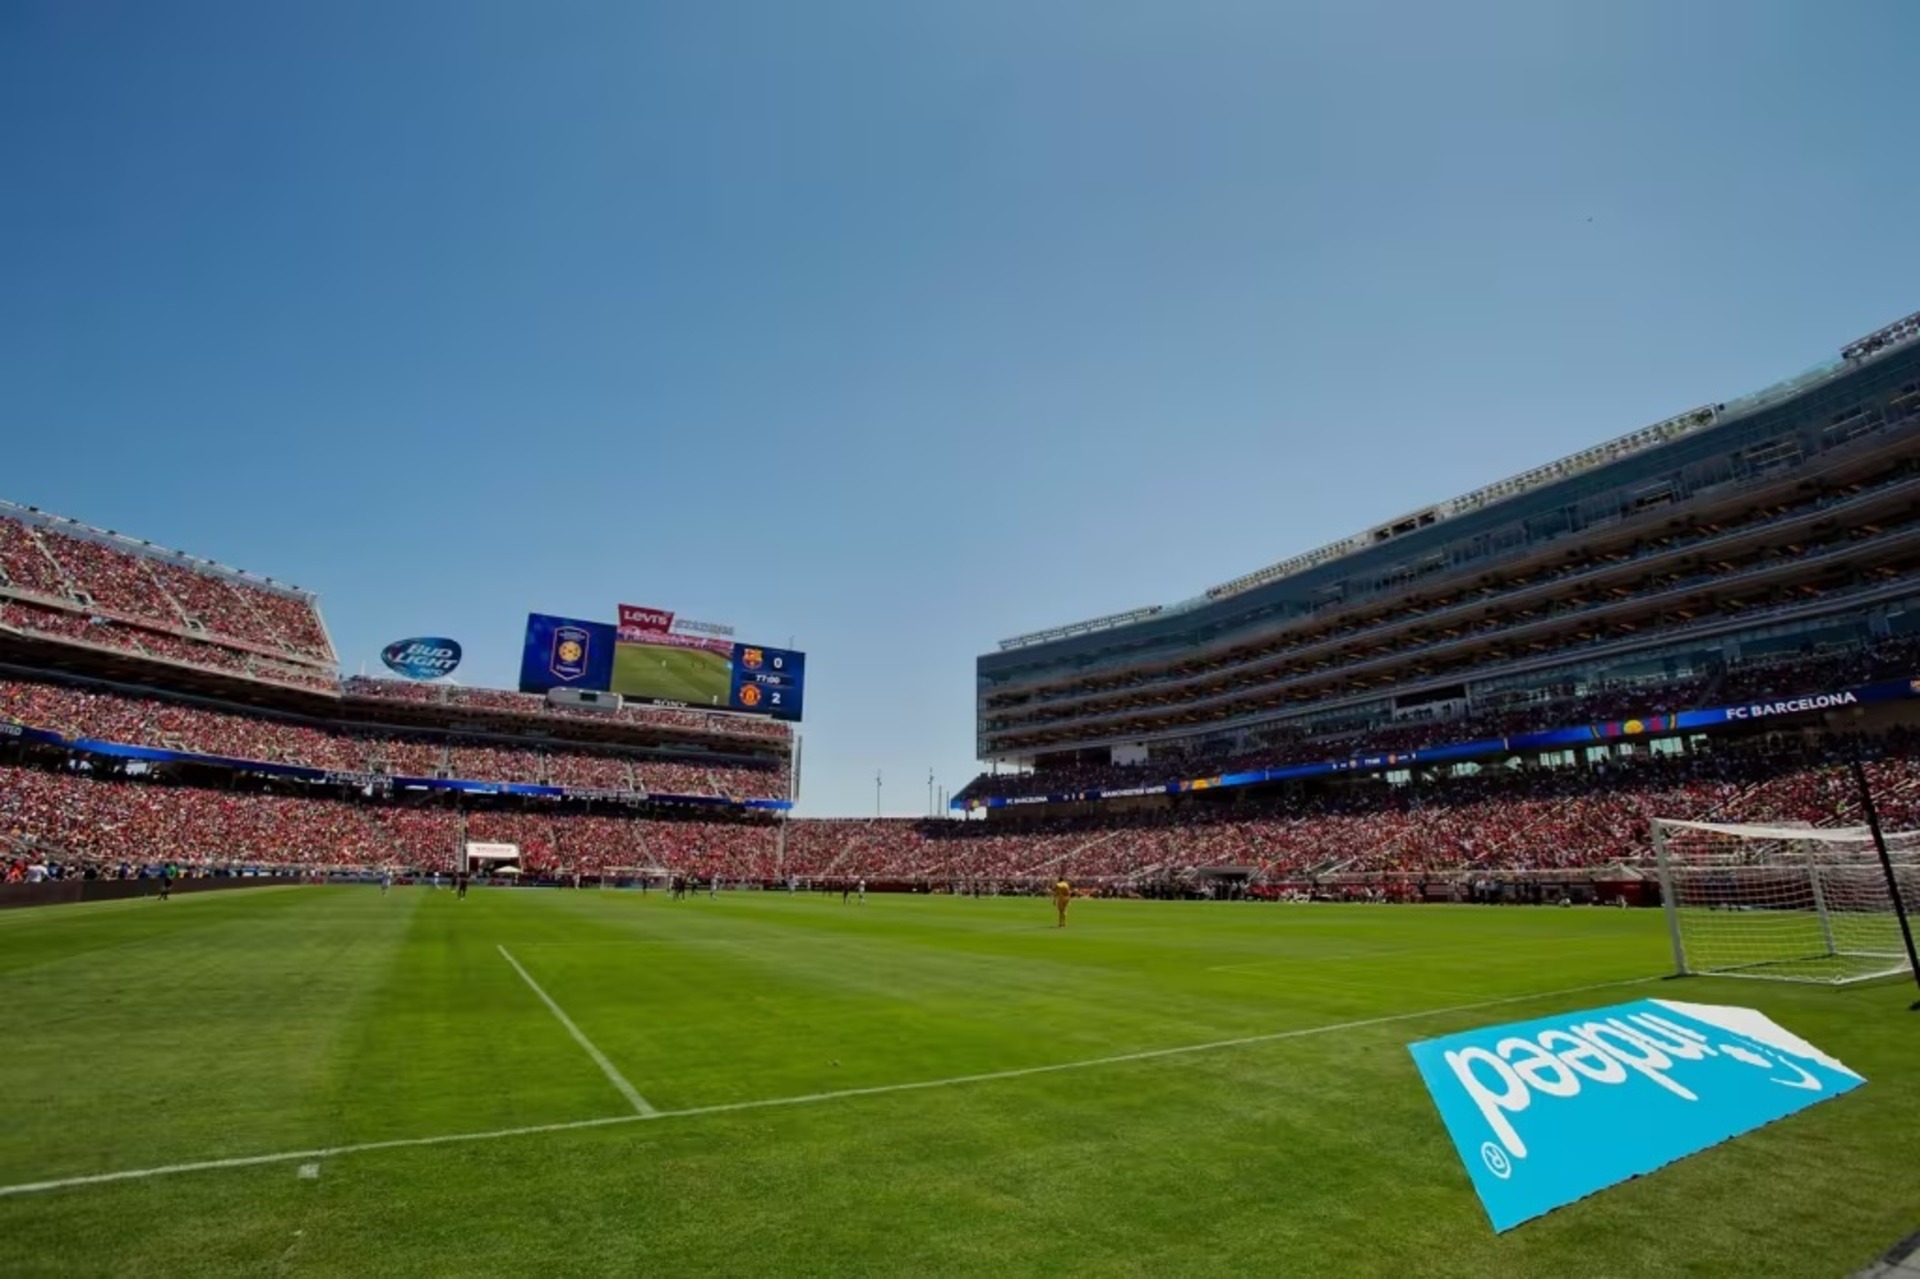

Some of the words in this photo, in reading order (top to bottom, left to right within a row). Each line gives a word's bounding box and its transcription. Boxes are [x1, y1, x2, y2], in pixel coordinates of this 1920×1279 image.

[407, 644, 453, 658] BUD
[393, 652, 457, 668] LIGHT
[774, 658, 782, 668] 0
[772, 692, 781, 704] 2
[1726, 707, 1748, 720] FC
[1751, 692, 1857, 717] BARCELONA
[1444, 1011, 1772, 1158] indeed
